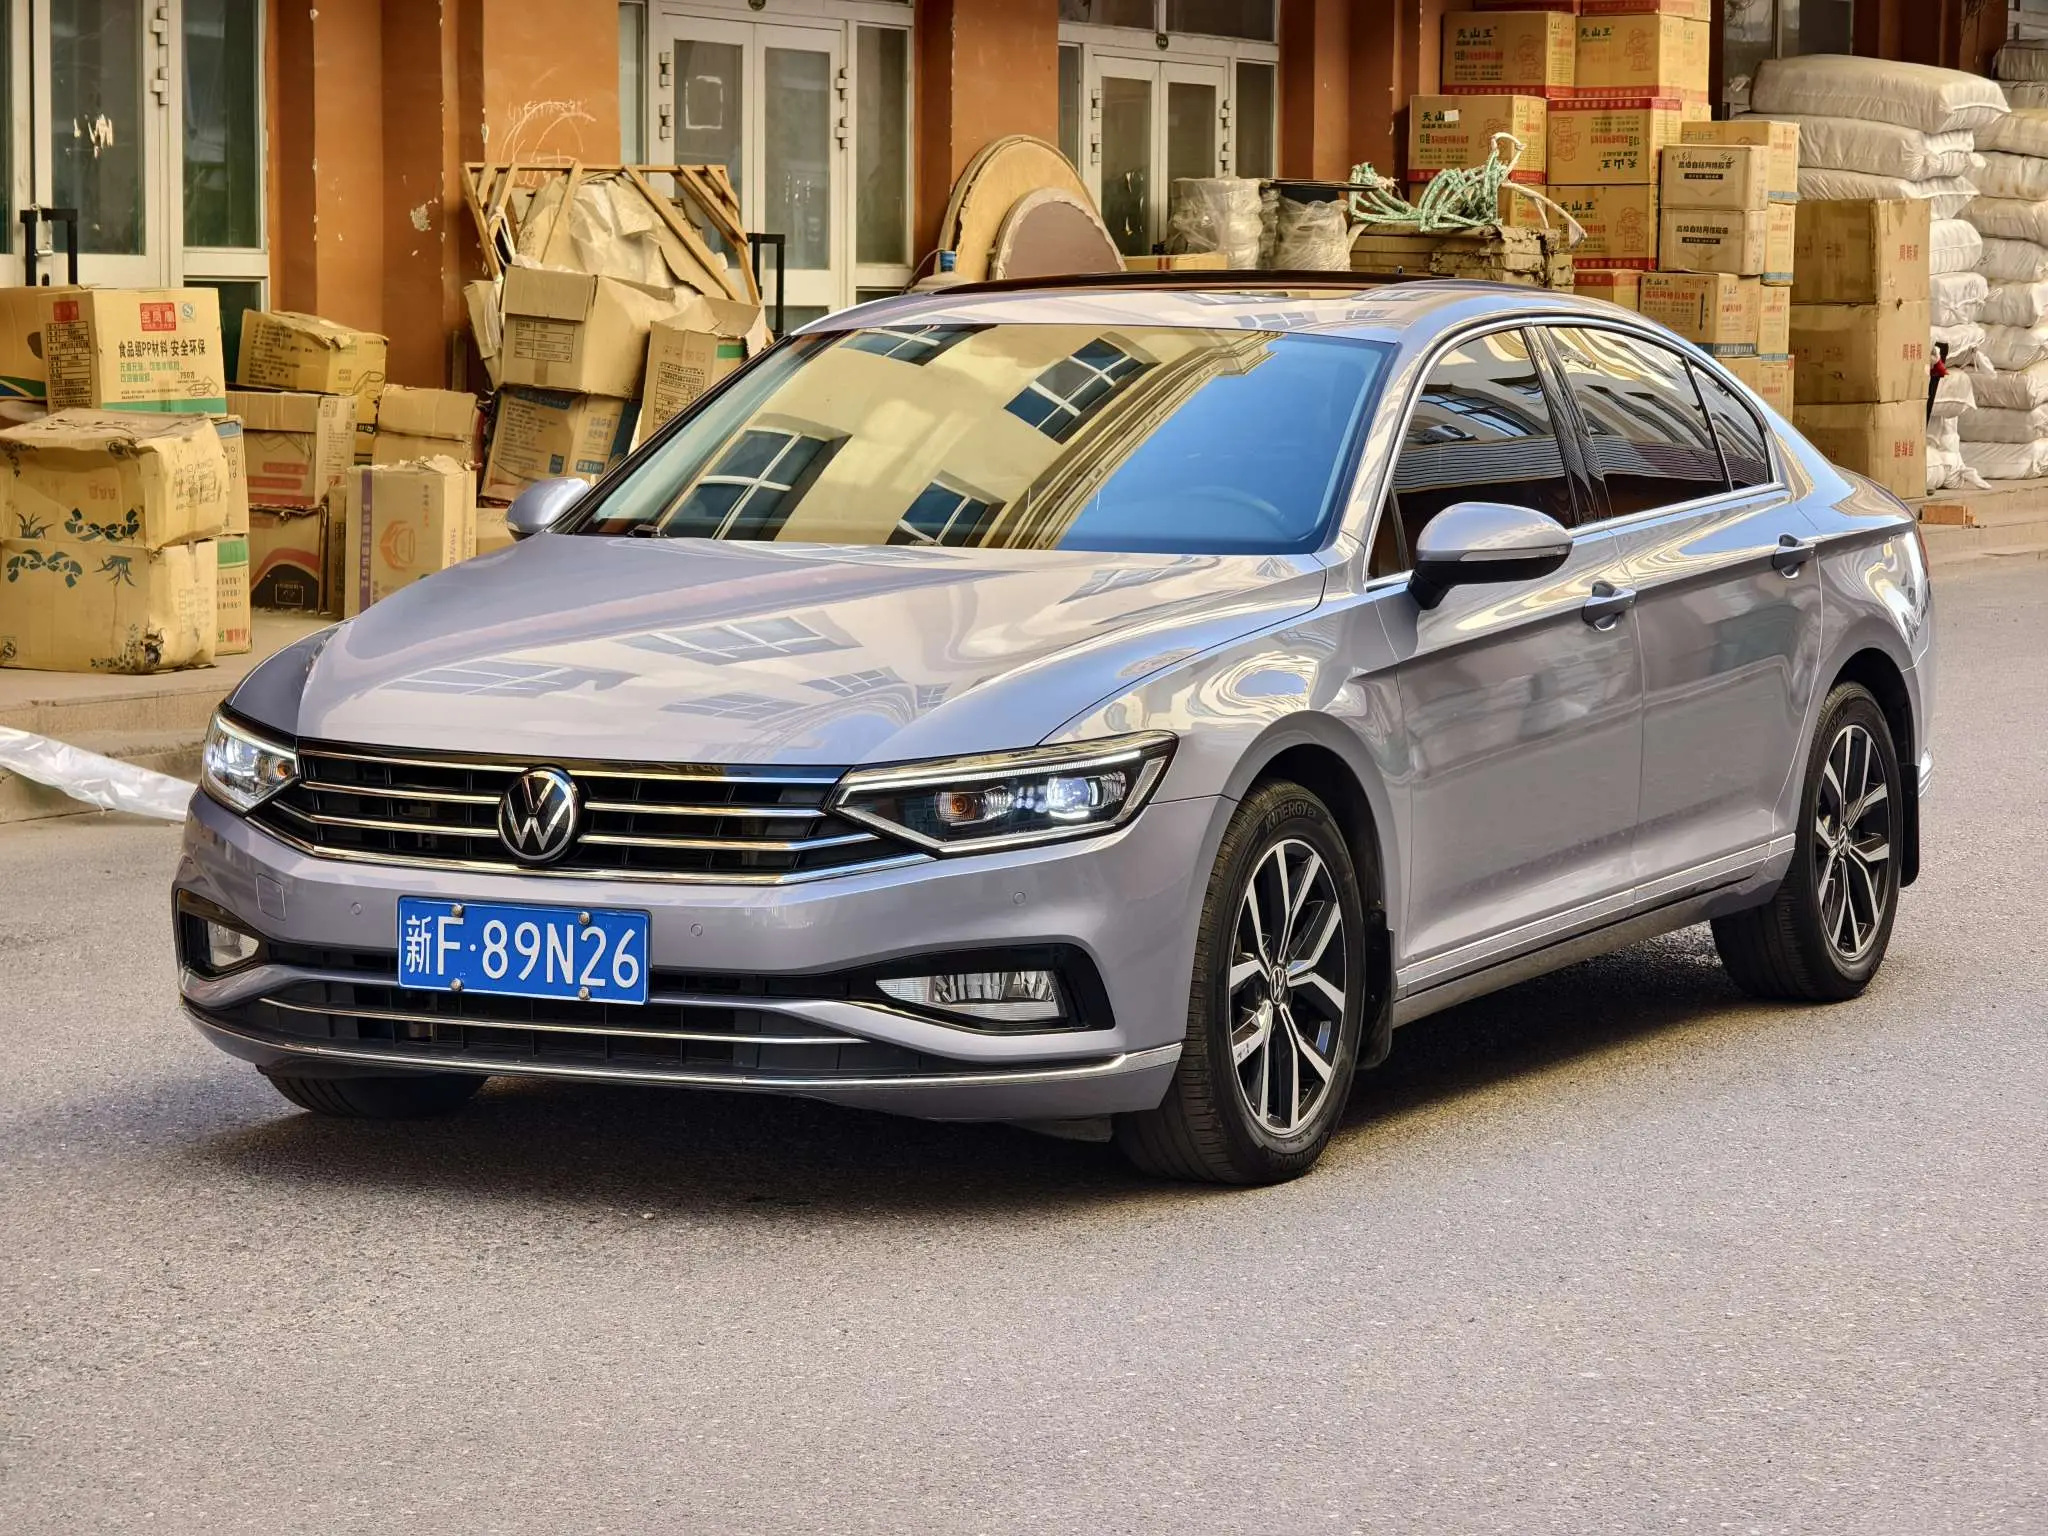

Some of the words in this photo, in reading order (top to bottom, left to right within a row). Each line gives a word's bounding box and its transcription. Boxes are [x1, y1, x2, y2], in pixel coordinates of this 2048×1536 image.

[1457, 27, 1493, 38] 天山王
[1580, 27, 1612, 37] 天山王
[1560, 200, 1595, 211] 天山王
[170, 338, 206, 357] 安全环保
